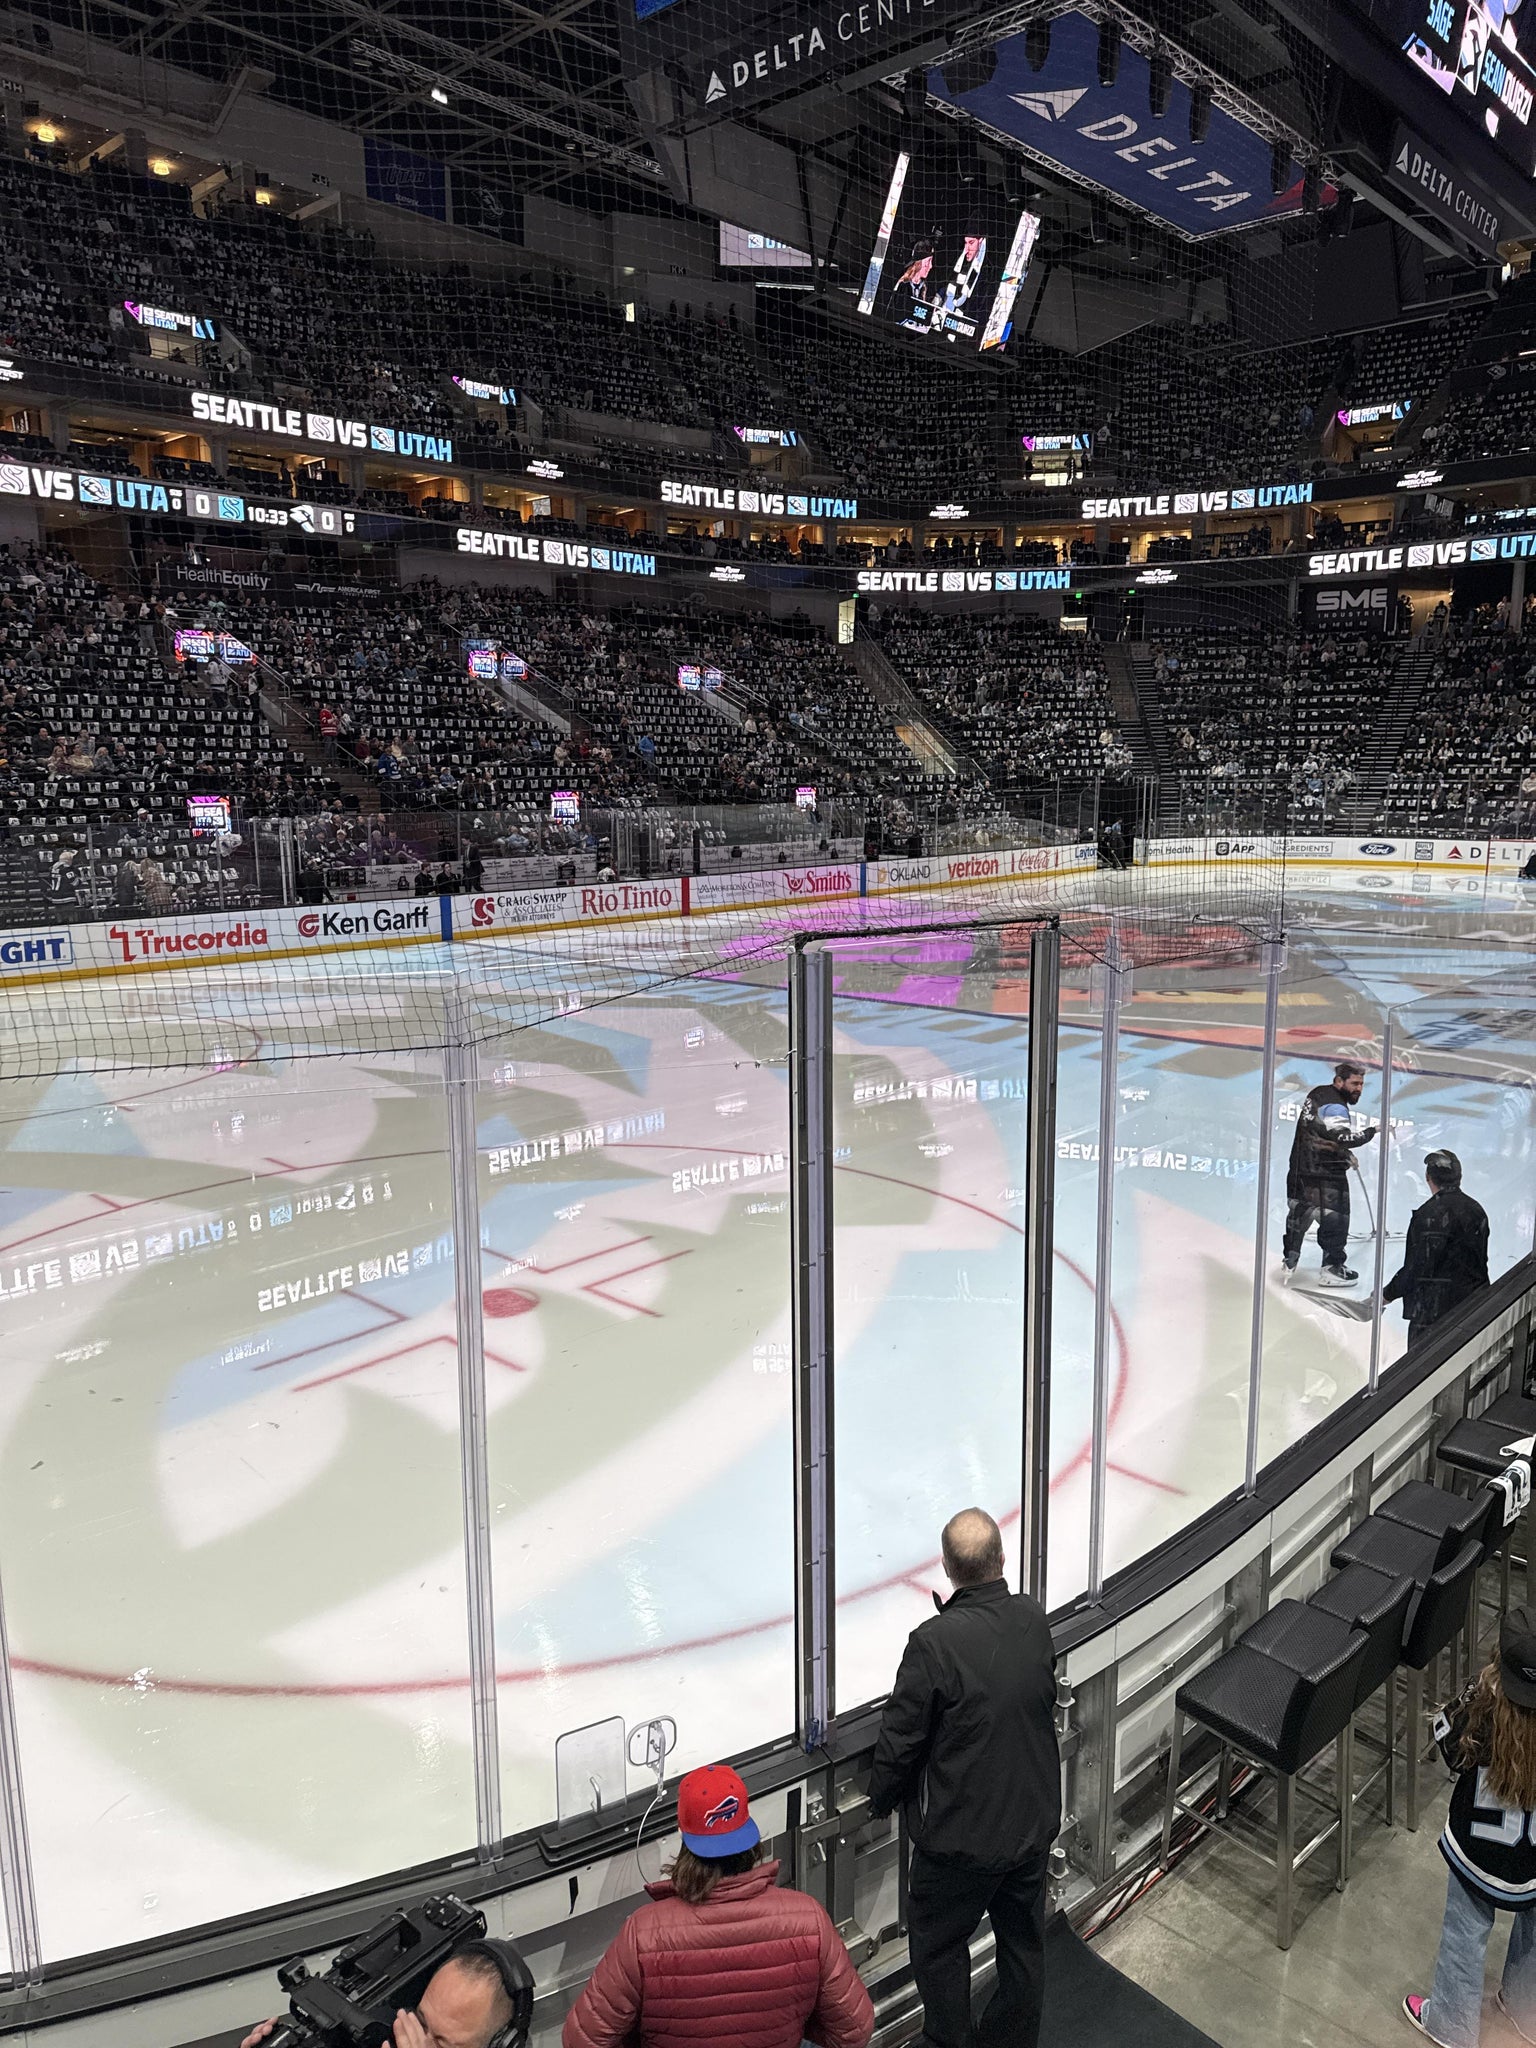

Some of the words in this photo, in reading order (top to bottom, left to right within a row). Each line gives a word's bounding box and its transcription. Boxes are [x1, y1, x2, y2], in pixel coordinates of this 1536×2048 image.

[1426, 0, 1455, 43] SAGE
[733, 27, 826, 88] DELTA
[1076, 114, 1252, 212] DELTA
[1411, 152, 1454, 206] DELTA
[1456, 190, 1498, 240] CENTER
[154, 308, 191, 326] SEATTLE
[155, 318, 177, 330] UTAH
[913, 305, 928, 319] SAGE
[191, 392, 301, 436] SEATTLE
[336, 421, 367, 448] VS
[398, 431, 452, 462] UTAH
[31, 469, 74, 501] VS
[195, 493, 210, 515] 0
[247, 506, 288, 526] 10:33
[321, 511, 335, 531] 0
[661, 480, 736, 510] SEATTLE
[760, 493, 784, 515] VS
[810, 497, 857, 519] UTAH
[1082, 495, 1170, 519] SEATTLE
[1200, 490, 1228, 512] VS
[1258, 483, 1313, 507] UTAH
[457, 528, 540, 561] SEATTLE
[564, 544, 589, 567] VS
[612, 550, 656, 576] UTAH
[1309, 547, 1403, 576] SEATTLE
[1436, 541, 1467, 565] VS
[176, 565, 271, 590] HealthEquity
[857, 571, 939, 591] SEATTLE
[966, 572, 993, 591] VS
[1019, 570, 1071, 590] UTAH
[1315, 588, 1388, 611] SME
[1317, 610, 1384, 619] INDUSTRIE
[1166, 845, 1194, 855] Health
[1363, 843, 1389, 857] Ford
[890, 866, 931, 883] OKLAND
[948, 857, 999, 879] verizon
[806, 870, 852, 894] Smith's
[497, 894, 532, 908] CRAIG
[533, 892, 567, 905] SWAPP
[511, 904, 561, 917] ASSOCIATES
[322, 911, 369, 936] Ken
[374, 906, 428, 932] Garff
[135, 923, 267, 954] Trucordia
